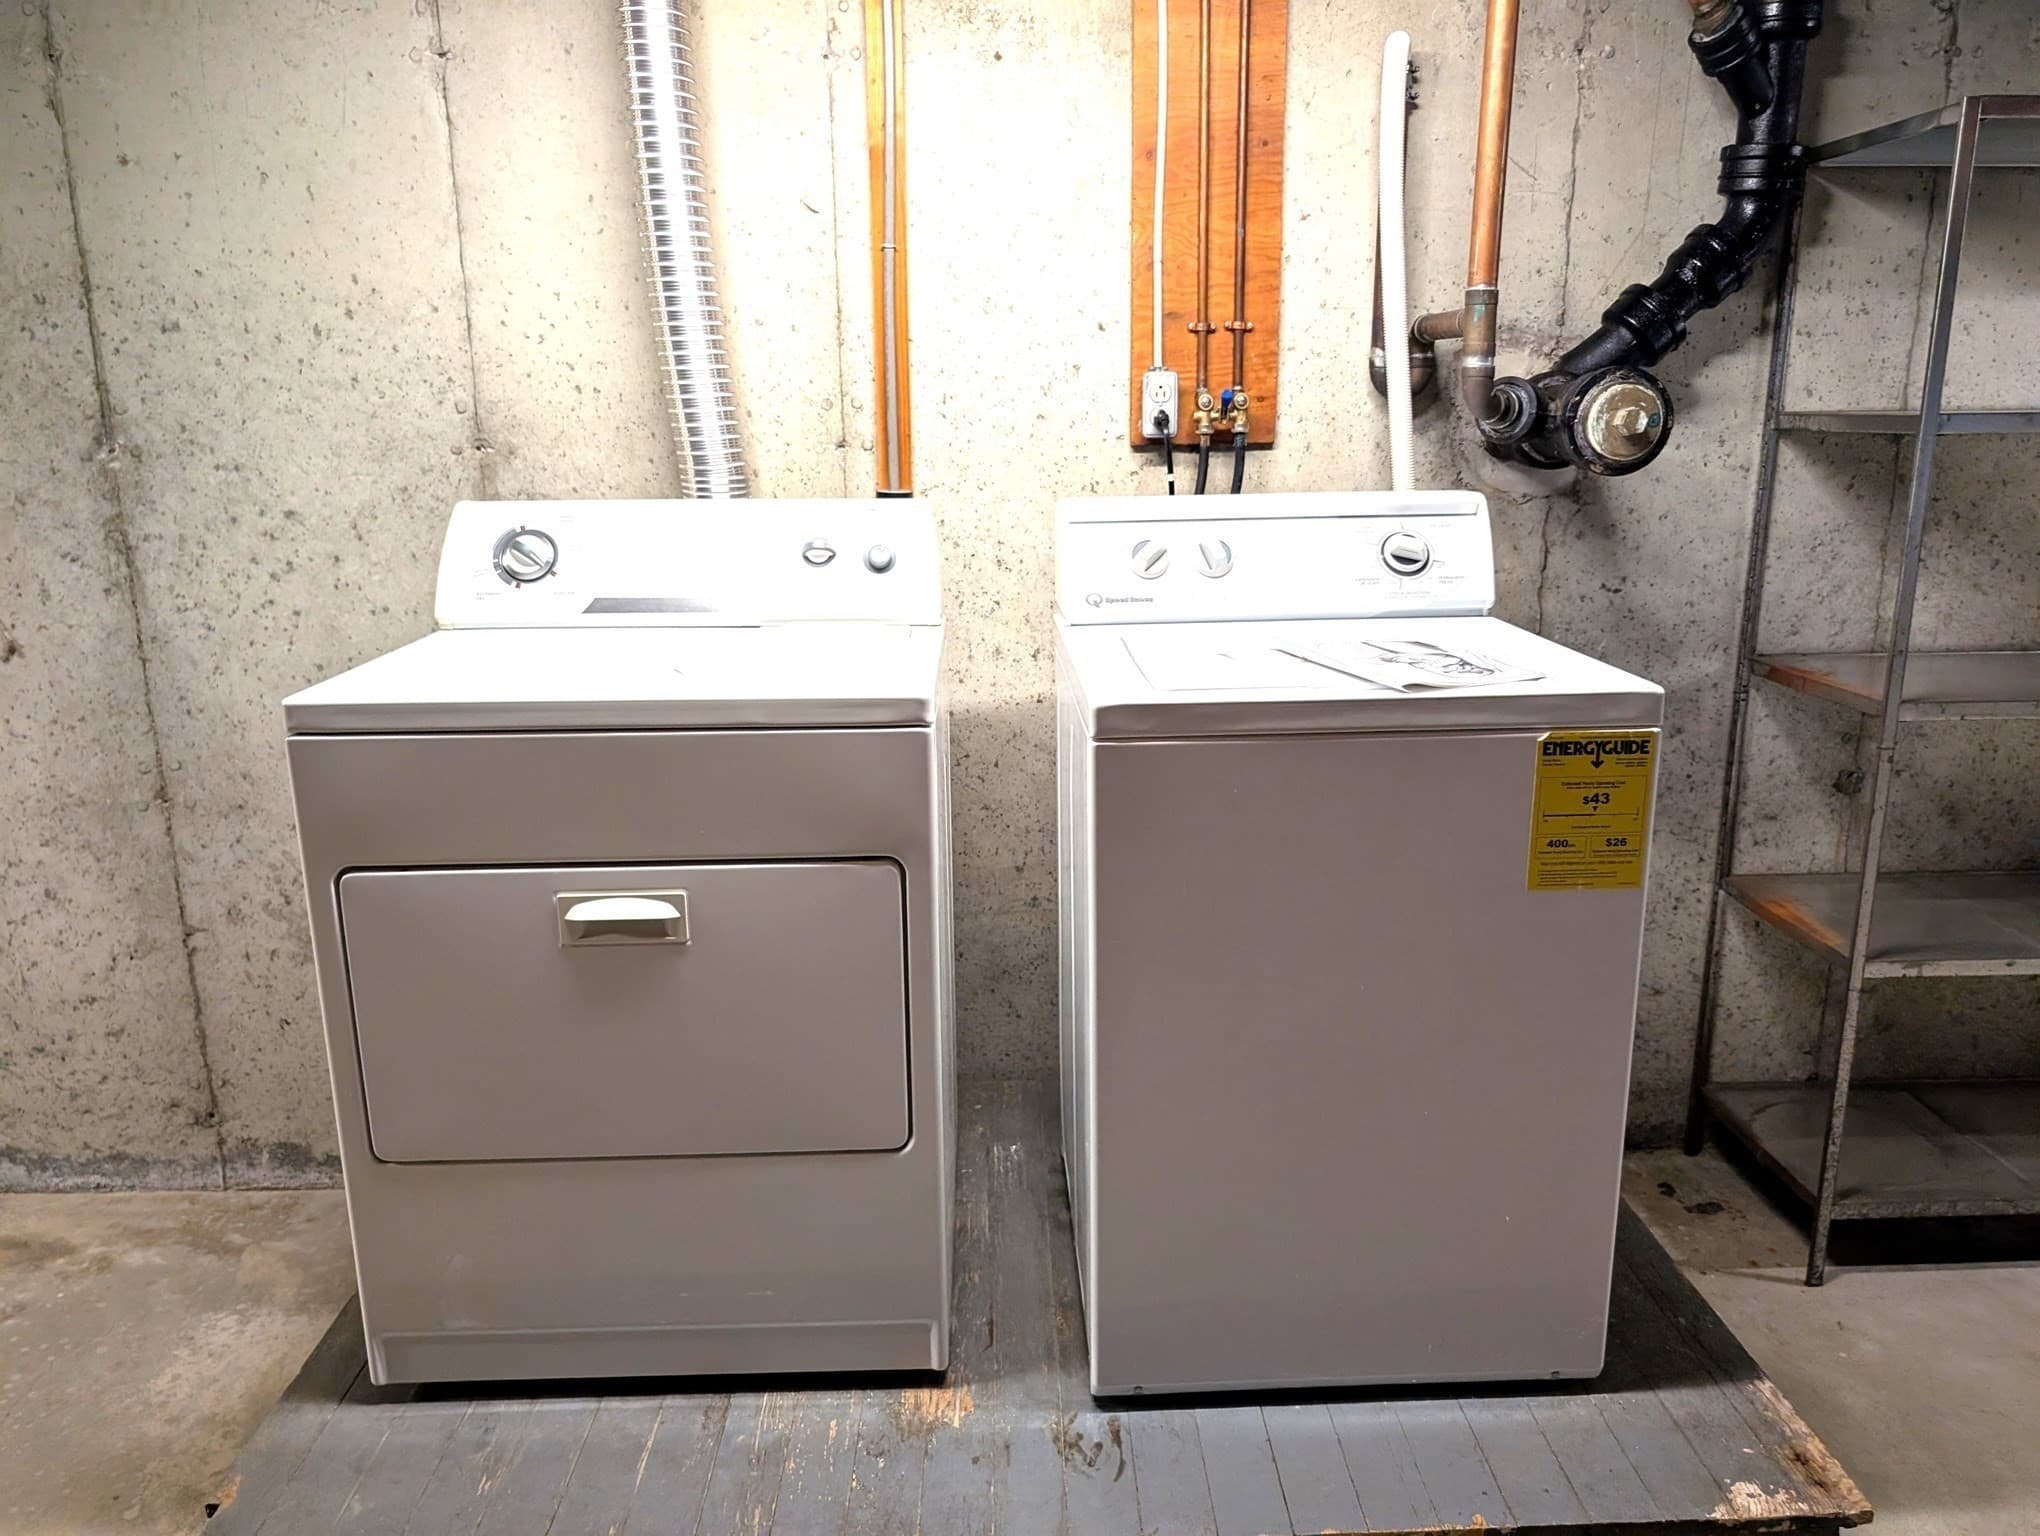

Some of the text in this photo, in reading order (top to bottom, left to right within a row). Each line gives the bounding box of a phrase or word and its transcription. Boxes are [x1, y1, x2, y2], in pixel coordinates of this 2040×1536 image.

[1542, 740, 1651, 756] ENERGYGUIDE
[1582, 793, 1610, 805] $43
[1547, 839, 1568, 848] 400
[1605, 837, 1628, 847] $26
